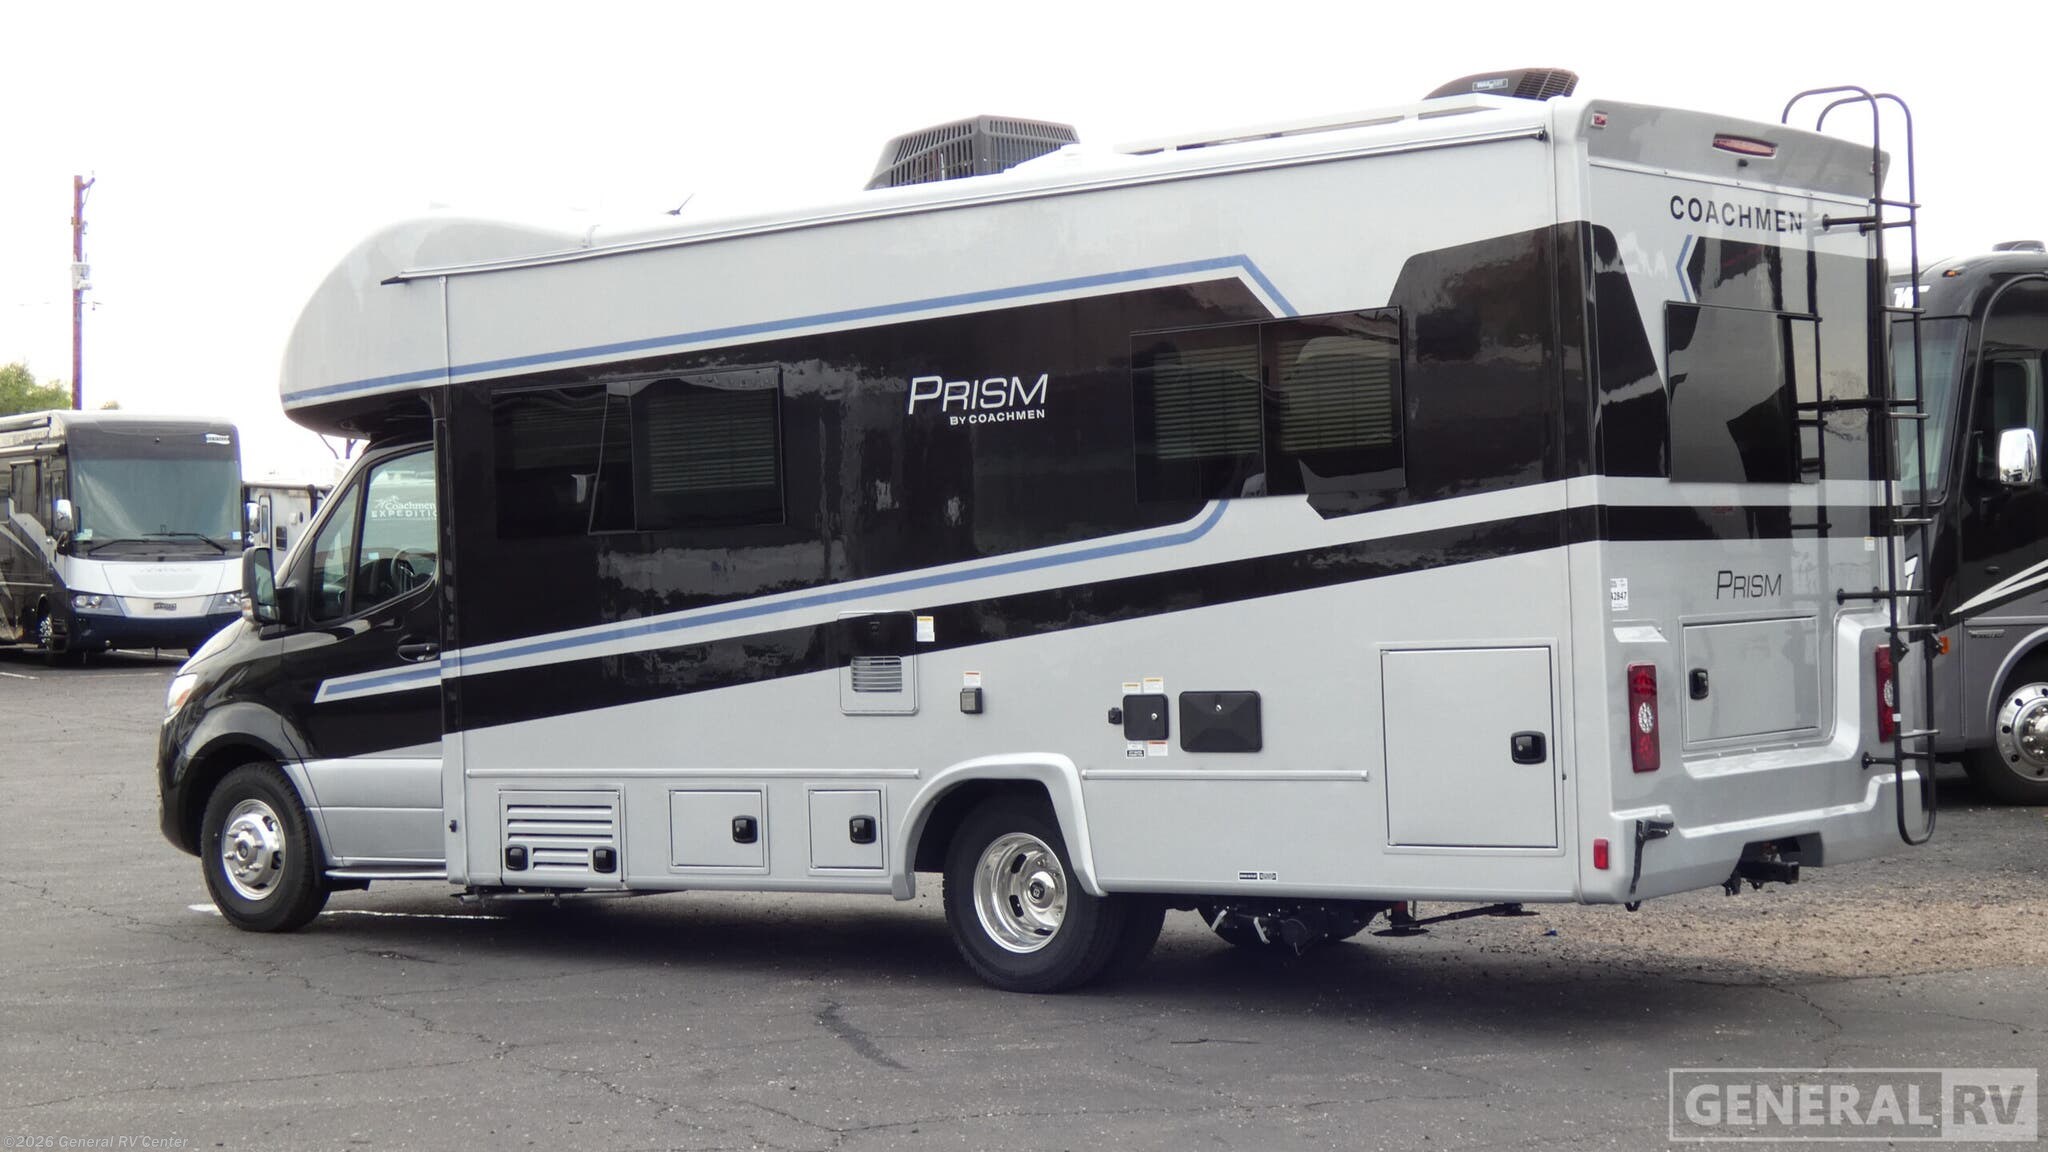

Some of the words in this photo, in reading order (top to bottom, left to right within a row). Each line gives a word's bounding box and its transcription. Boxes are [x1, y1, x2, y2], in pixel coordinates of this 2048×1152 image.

[1670, 195, 1803, 234] COACHMEN
[908, 373, 1049, 415] PRISM
[950, 415, 967, 426] BY
[968, 409, 1046, 424] COACHMEN
[1716, 569, 1783, 600] PRISM
